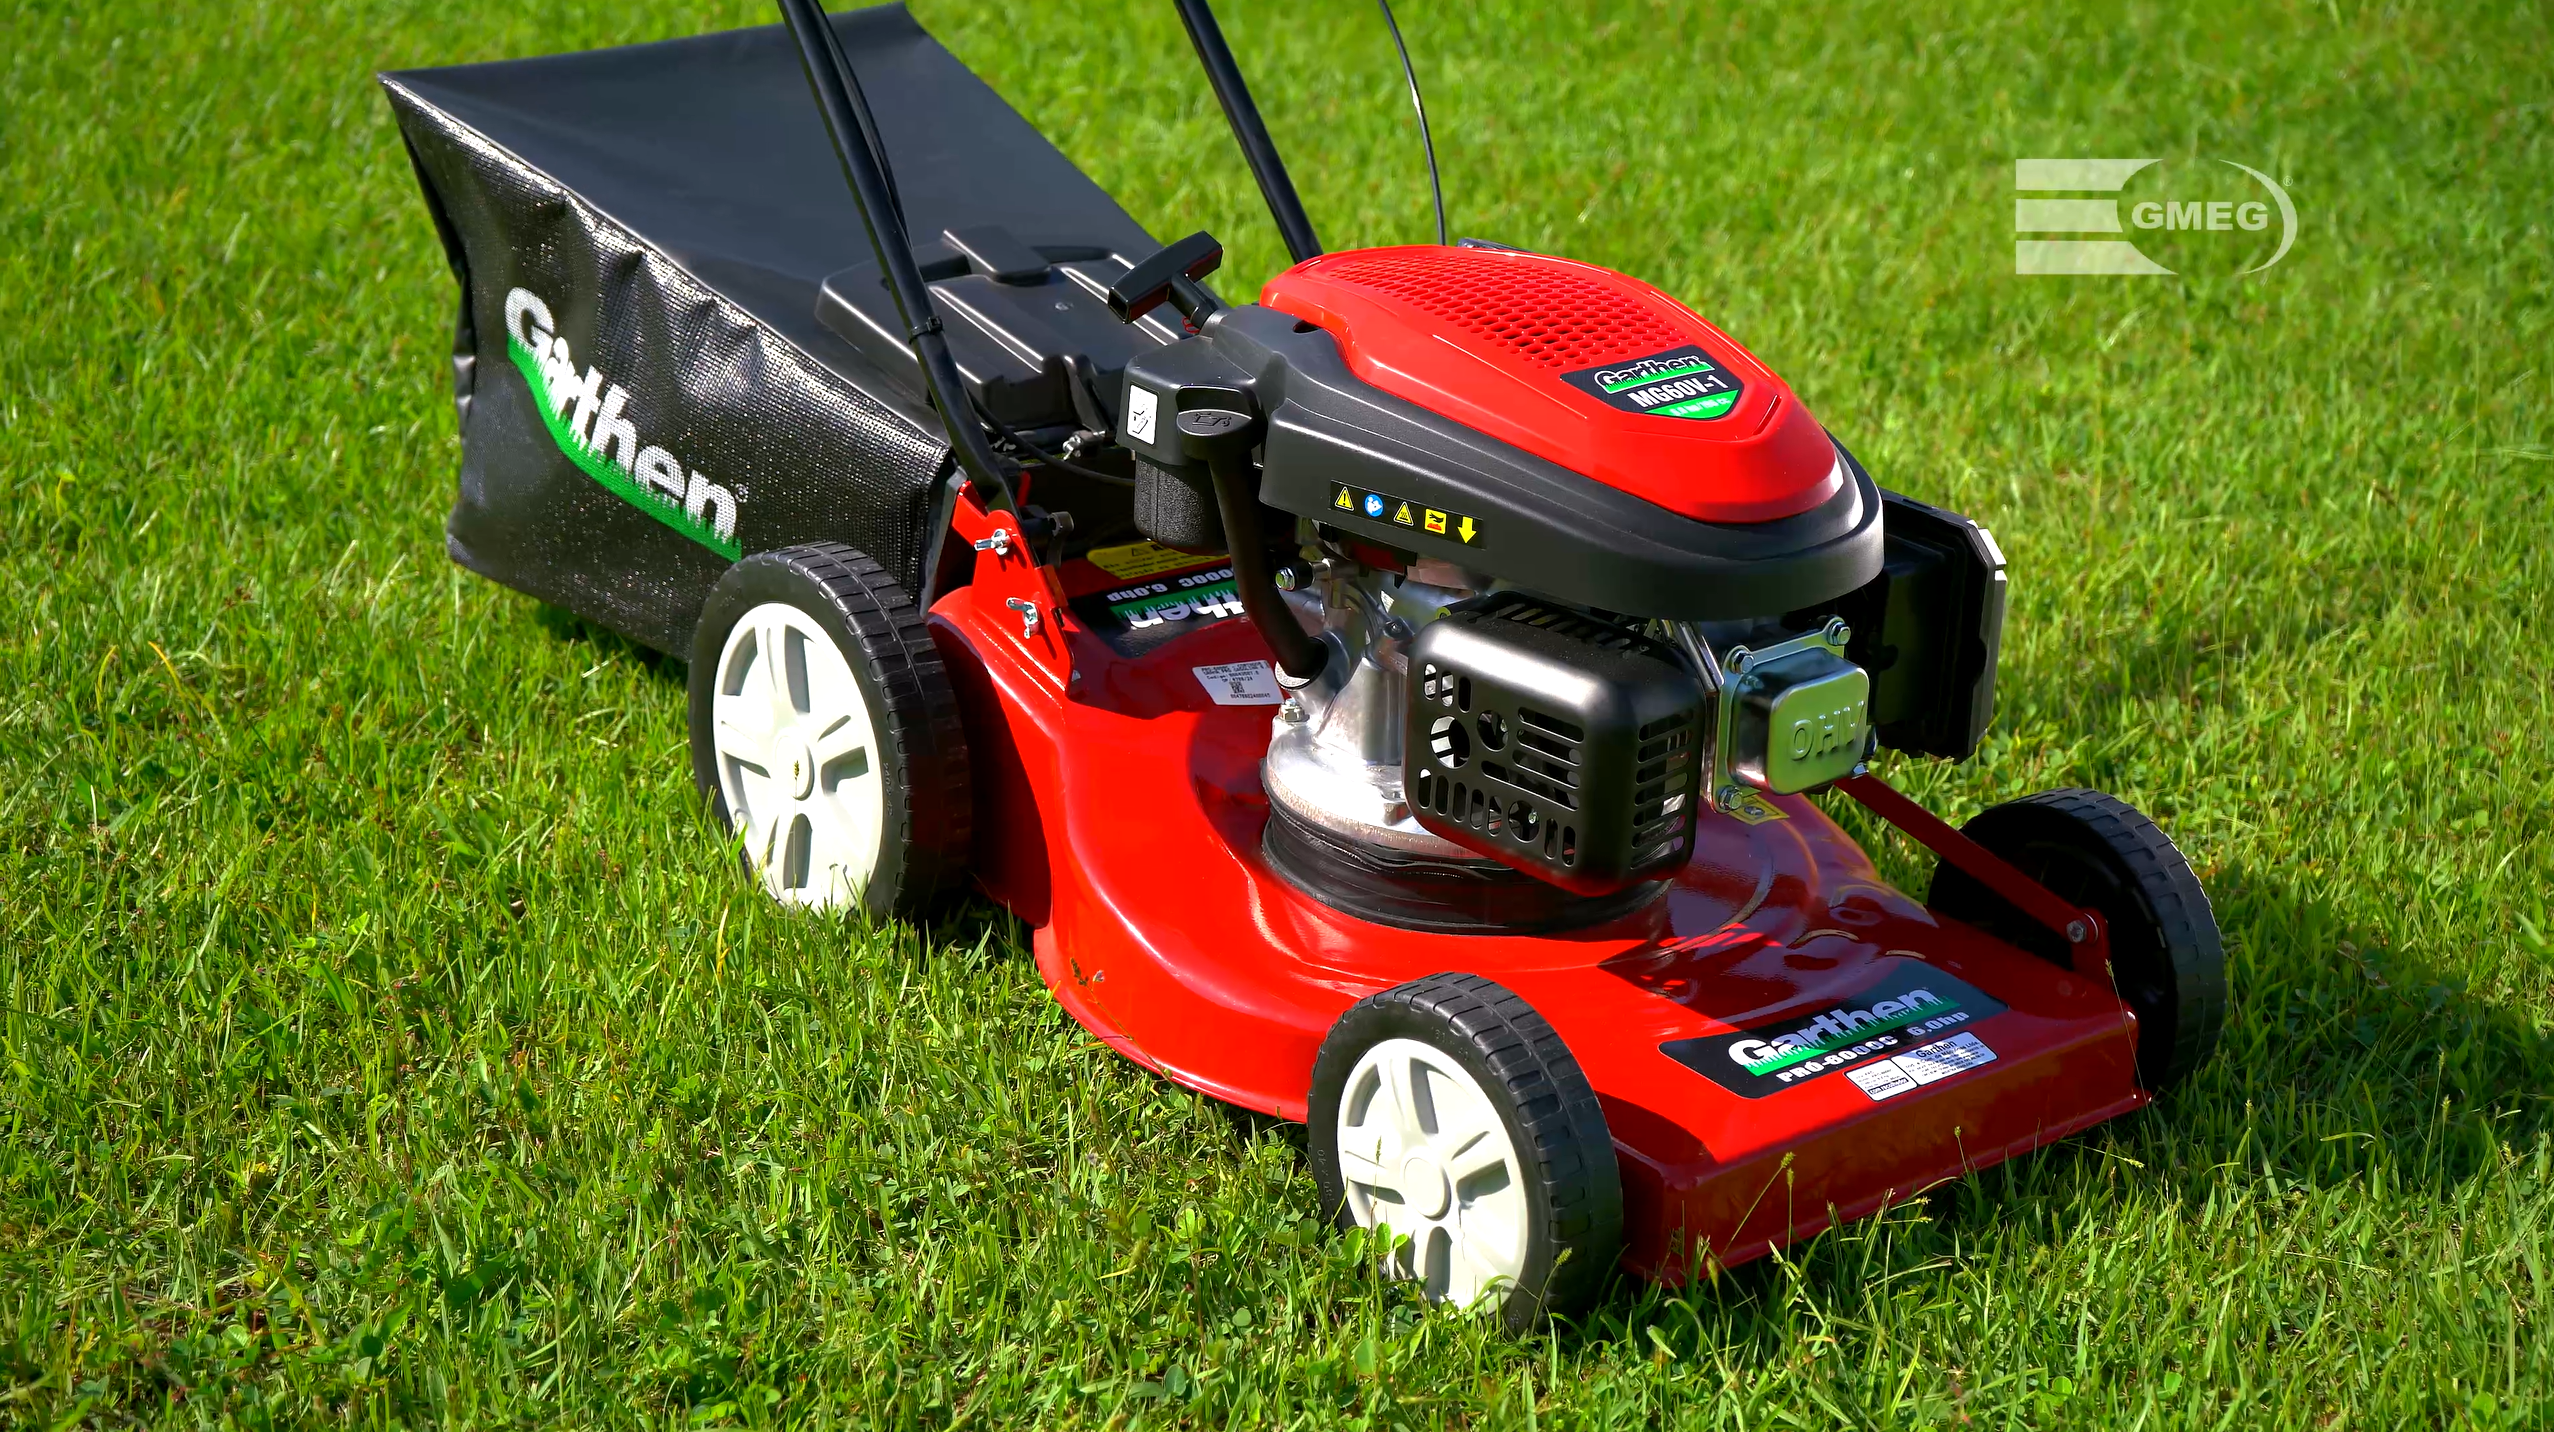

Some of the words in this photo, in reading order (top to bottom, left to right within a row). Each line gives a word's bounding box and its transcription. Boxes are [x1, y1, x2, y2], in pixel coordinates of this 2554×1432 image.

[1594, 355, 1706, 390] Garthen
[1627, 374, 1729, 408] MG60V-1
[503, 286, 738, 546] Garthen
[1127, 589, 1246, 630] then
[1789, 700, 1865, 761] OHV
[1728, 987, 1943, 1070] Garthen
[1915, 1041, 1958, 1058] Garthen
